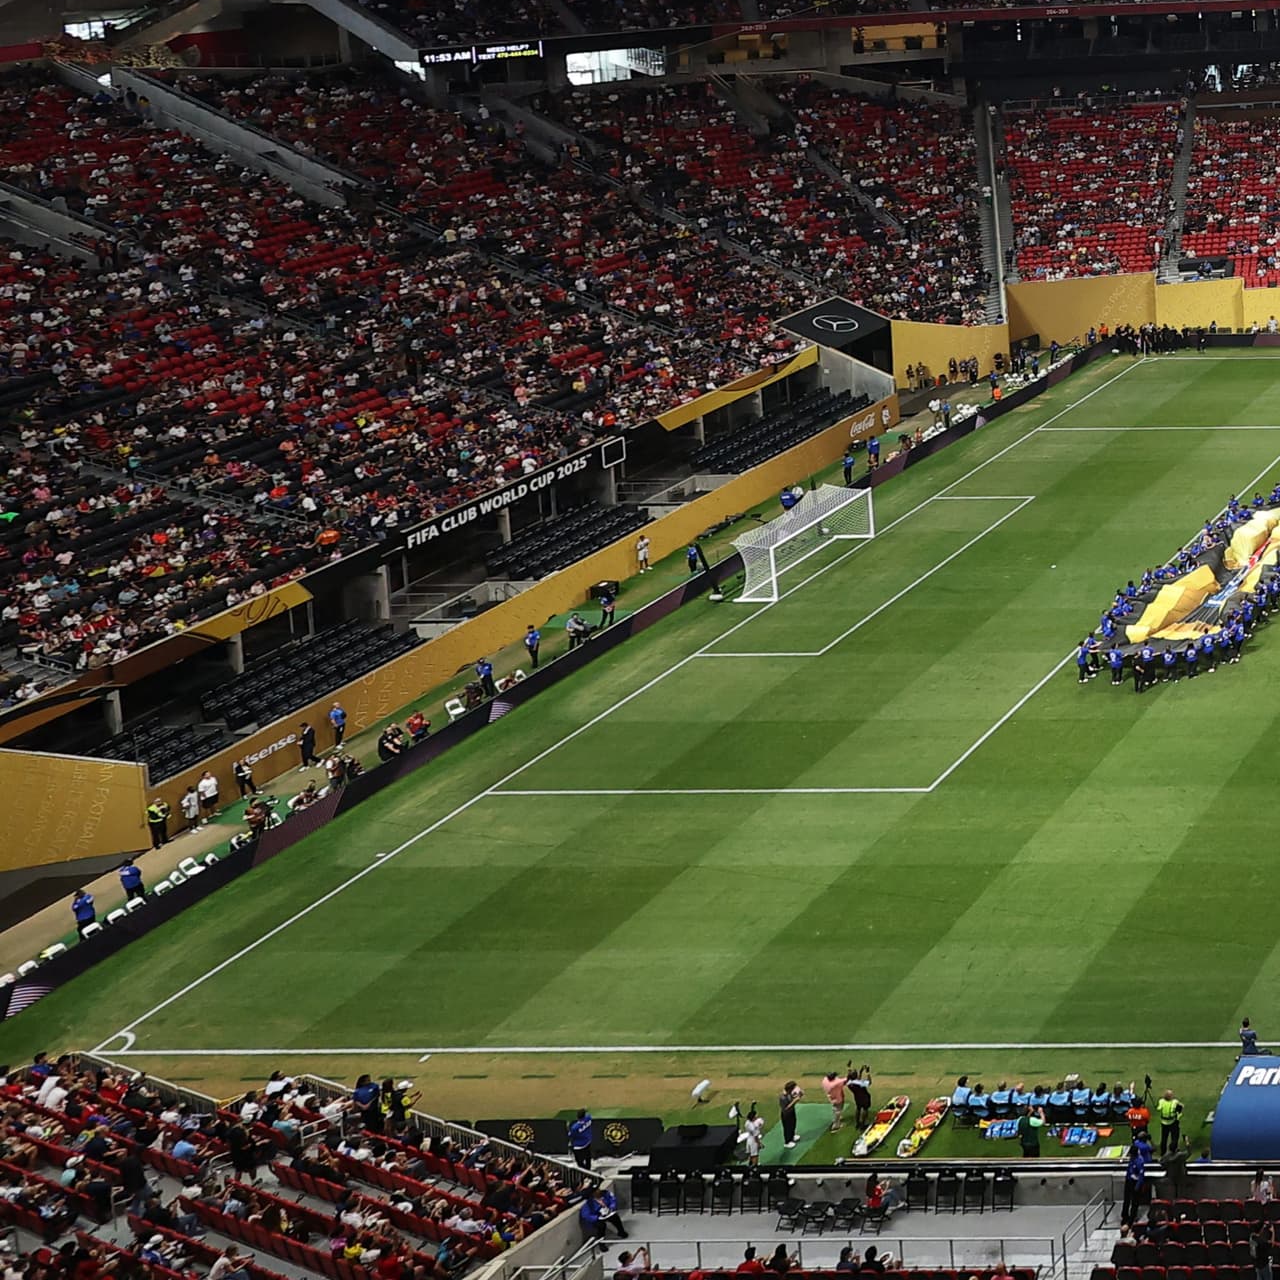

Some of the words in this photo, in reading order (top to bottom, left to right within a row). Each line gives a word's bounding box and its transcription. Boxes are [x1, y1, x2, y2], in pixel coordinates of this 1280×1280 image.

[423, 53, 452, 63] 11:53
[453, 51, 471, 61] AM
[407, 526, 440, 549] FIFA
[441, 508, 477, 533] CLUB
[479, 484, 528, 516] WORLD
[529, 470, 556, 492] CUP
